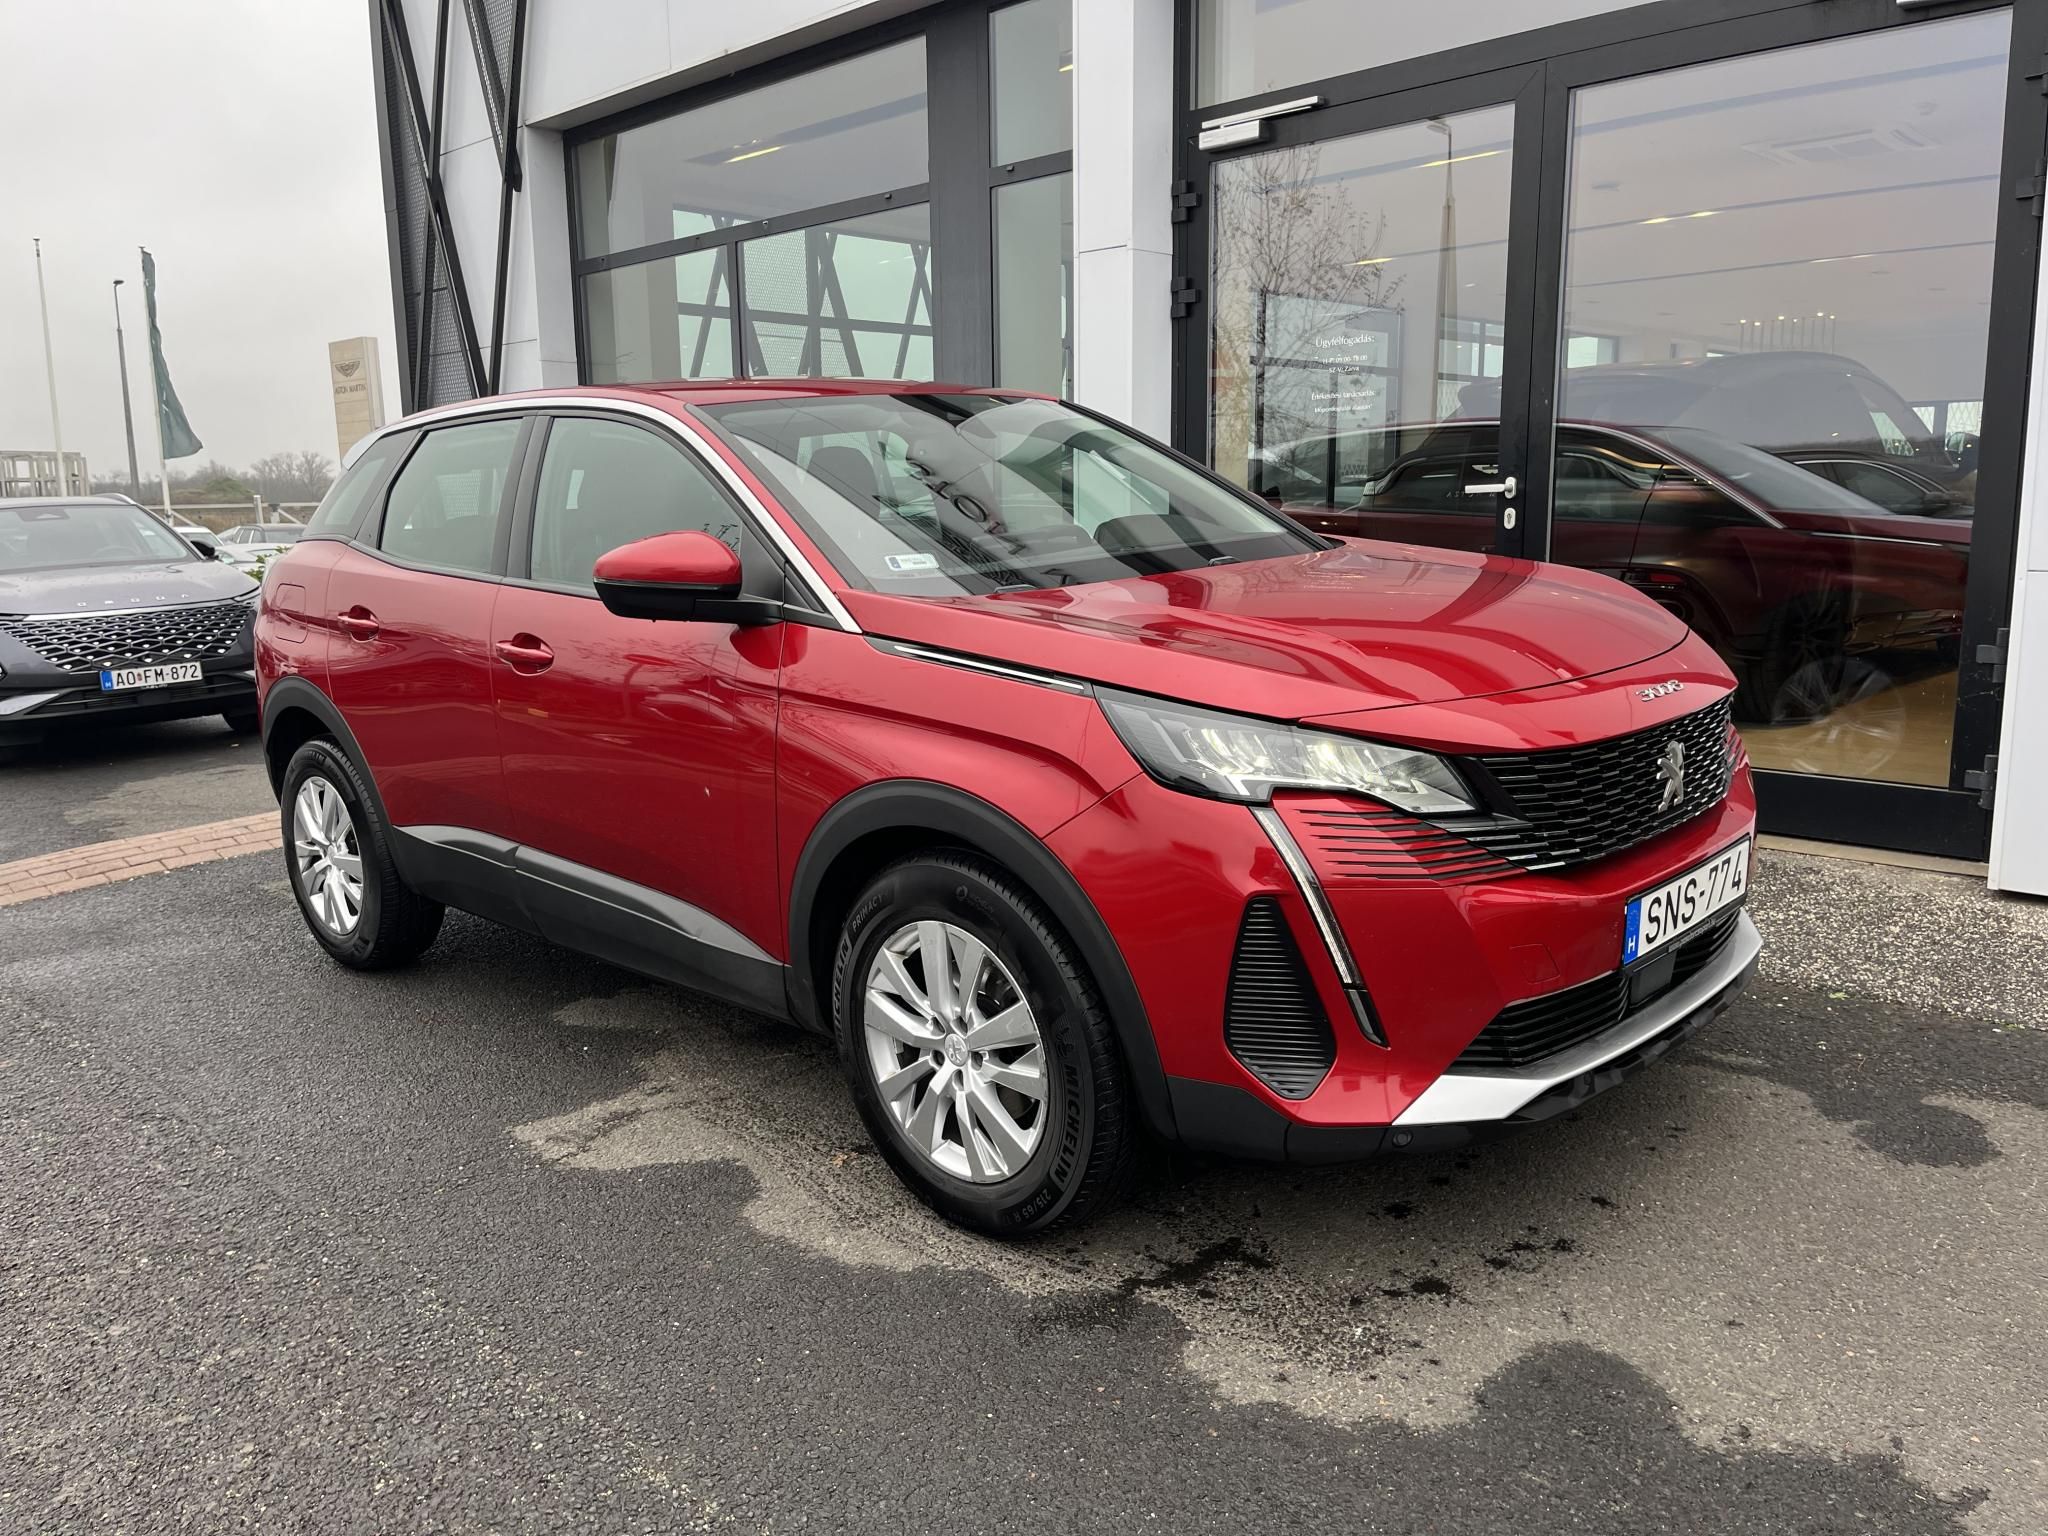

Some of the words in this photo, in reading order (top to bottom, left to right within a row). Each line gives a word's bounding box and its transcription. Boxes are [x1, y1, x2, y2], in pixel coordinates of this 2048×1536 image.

[143, 664, 200, 684] FM-872
[1635, 679, 1684, 702] 3008
[852, 893, 883, 933] PRIMACY
[1645, 850, 1742, 945] SNS-774
[1055, 1063, 1081, 1184] MICHELIN
